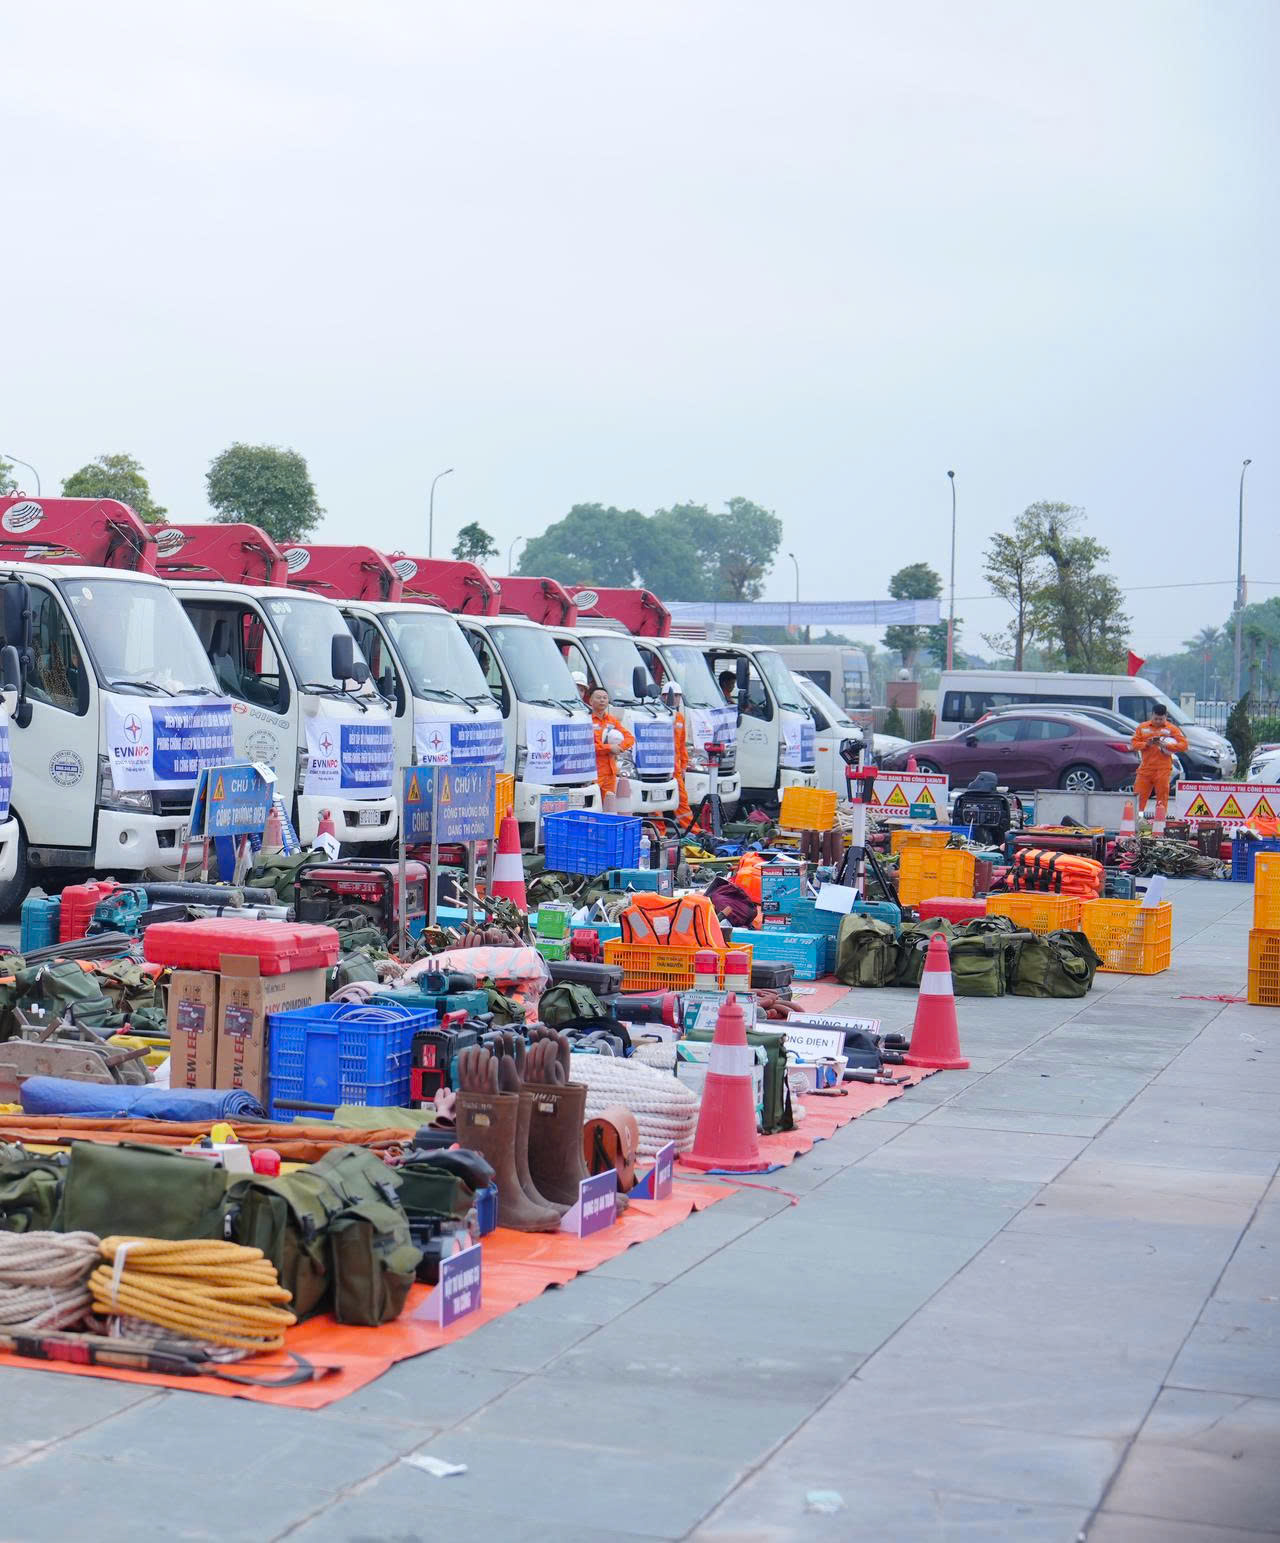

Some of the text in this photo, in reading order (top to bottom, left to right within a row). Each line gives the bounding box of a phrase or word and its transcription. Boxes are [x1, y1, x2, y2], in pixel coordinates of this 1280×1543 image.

[250, 710, 290, 730] HINO
[231, 775, 249, 793] CHÚ
[454, 772, 470, 794] CHÚ
[412, 808, 430, 832] CÔNG
